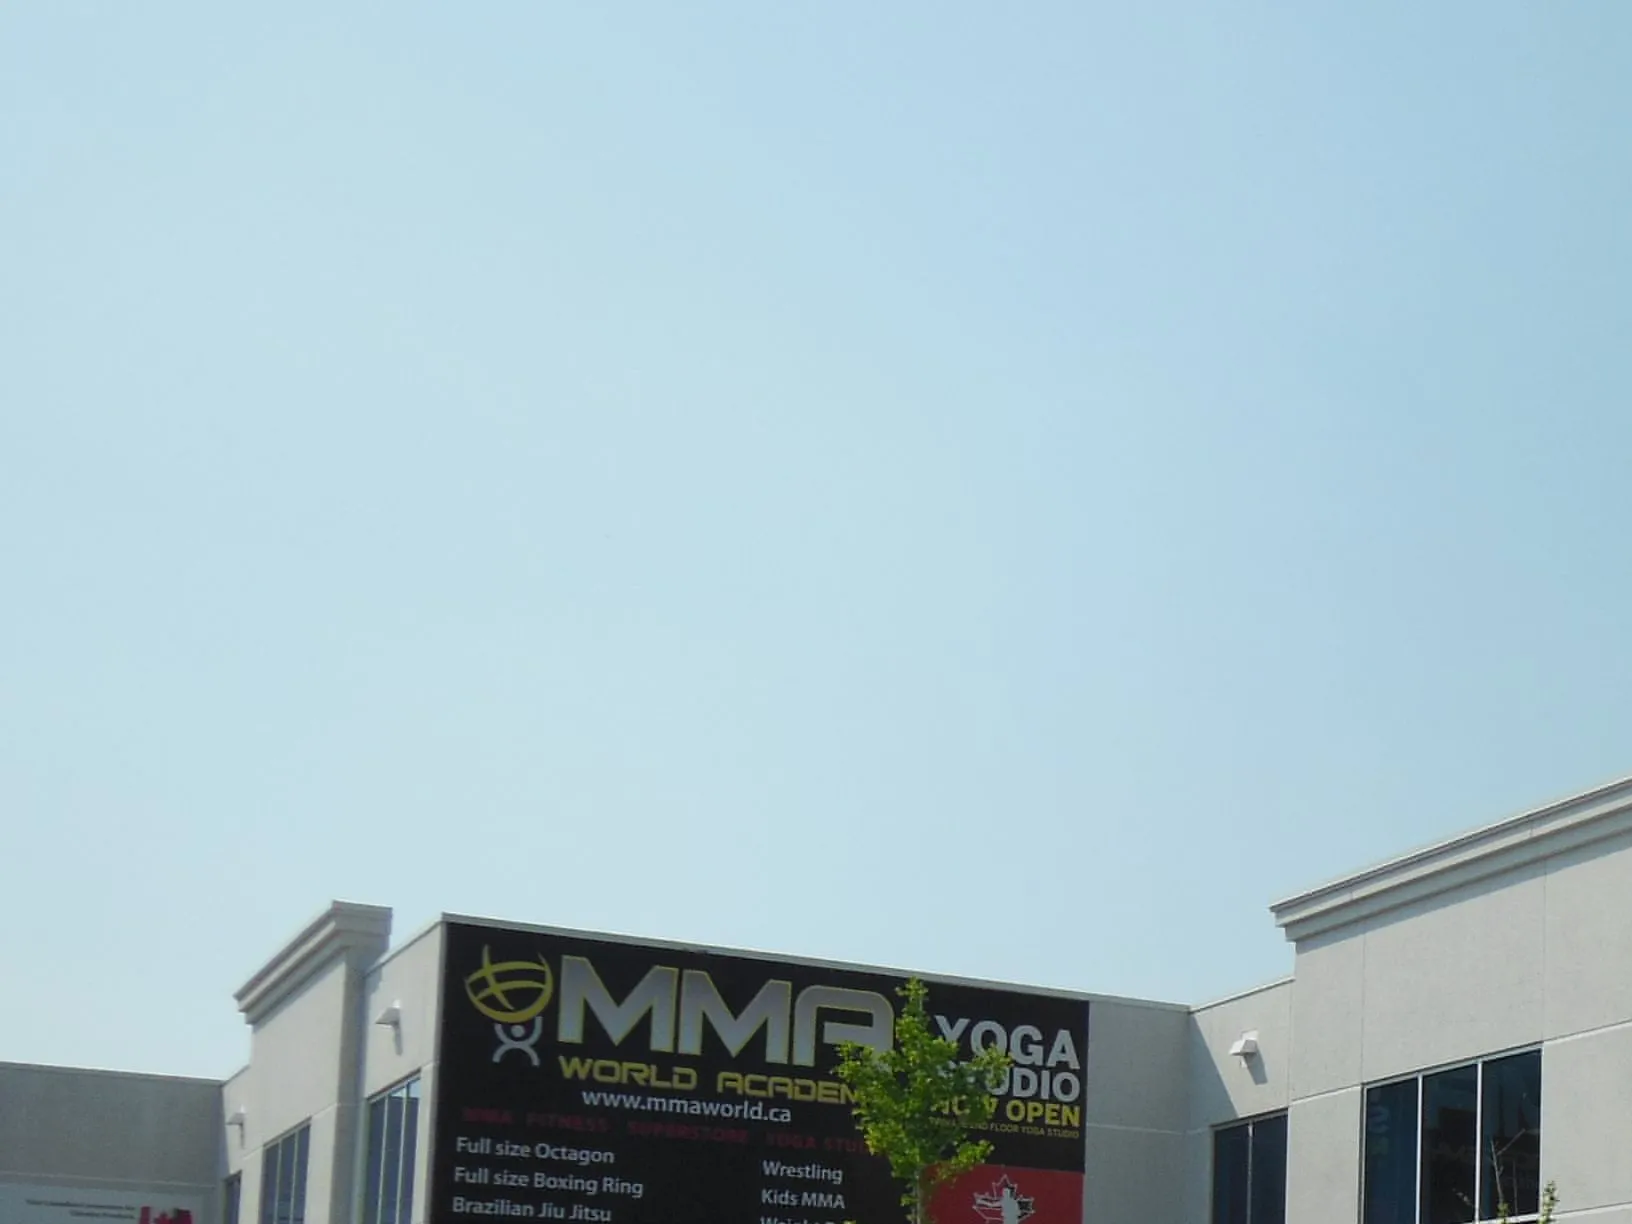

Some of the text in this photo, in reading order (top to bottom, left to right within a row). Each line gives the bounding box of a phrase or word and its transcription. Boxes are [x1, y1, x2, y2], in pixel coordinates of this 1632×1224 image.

[557, 954, 895, 1067] MMA
[934, 1014, 1081, 1070] YOGA
[558, 1055, 858, 1105] WORLD ACADEM
[938, 1060, 1081, 1103] UDIO
[582, 1091, 792, 1123] www.mmaworld.ca
[1005, 1099, 1081, 1127] OPEN
[456, 1137, 615, 1166] Full size Octagon
[454, 1167, 644, 1199] Full size Boxing Ring
[762, 1160, 843, 1185] Wrestling
[452, 1197, 612, 1222] Brazilian Jiu Jitsu
[761, 1189, 846, 1209] Kids MMA
